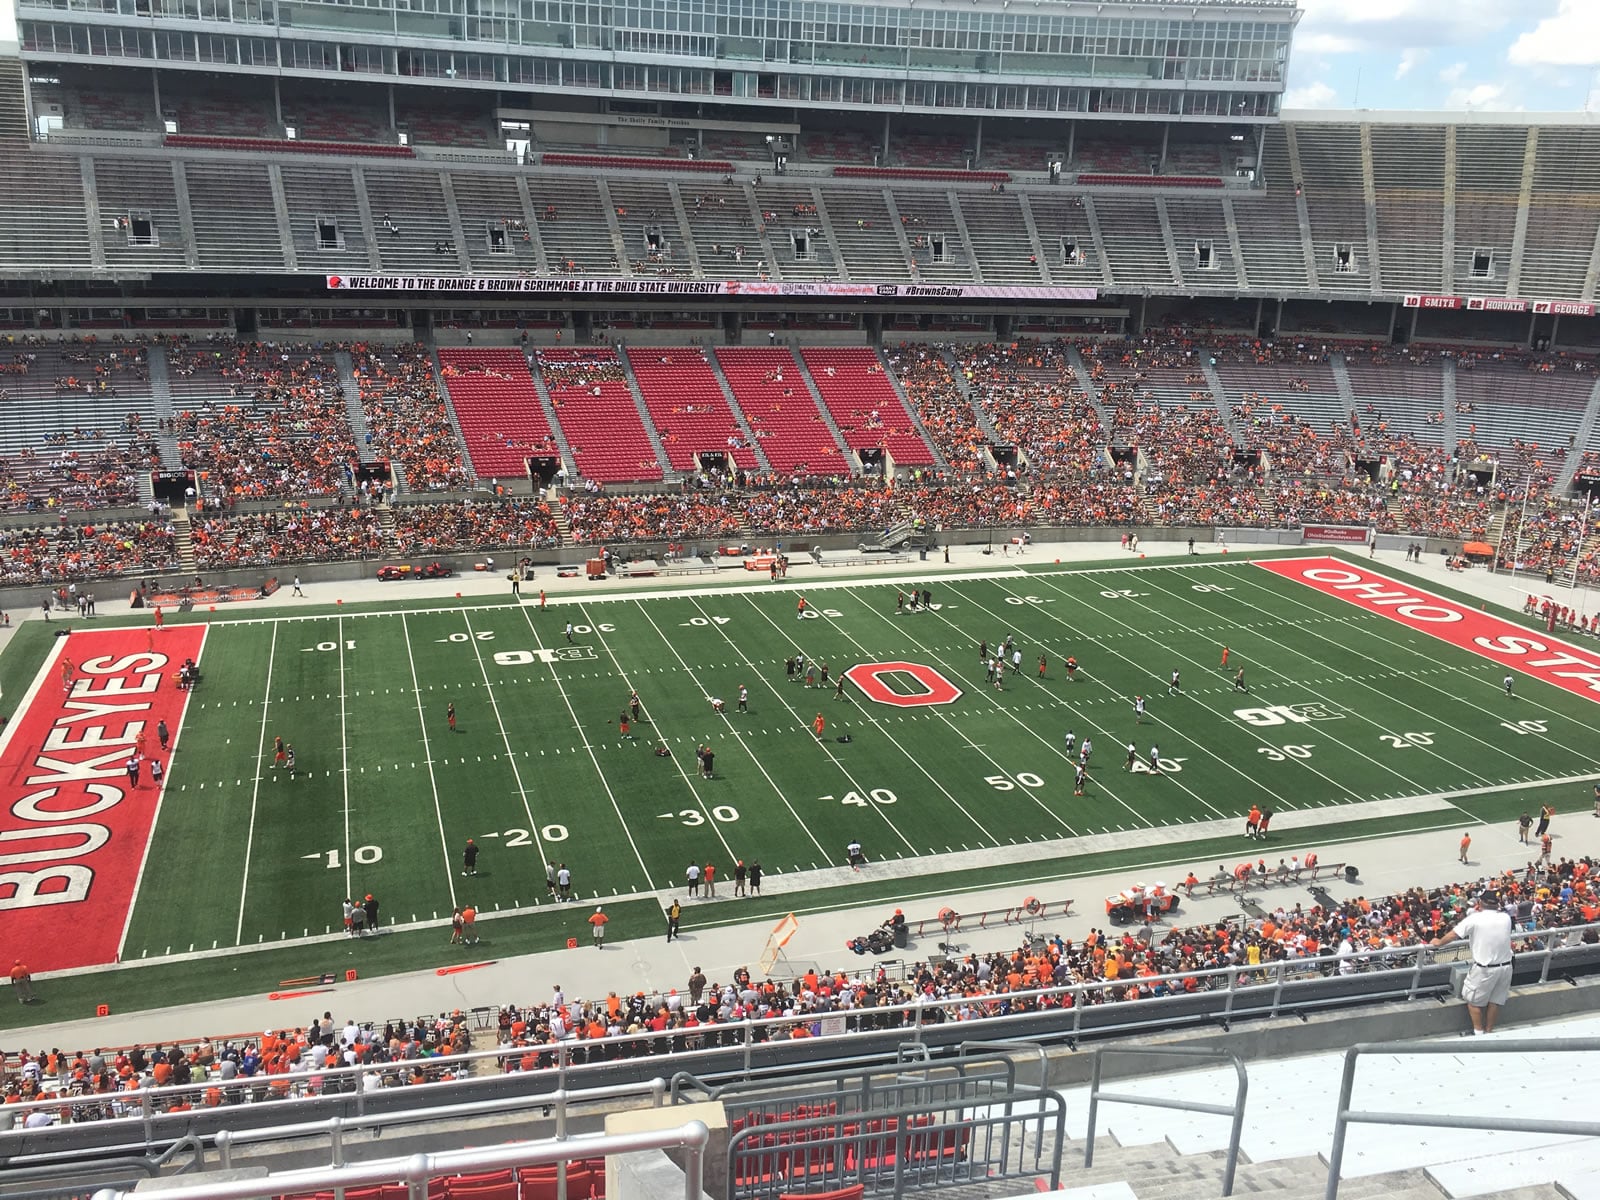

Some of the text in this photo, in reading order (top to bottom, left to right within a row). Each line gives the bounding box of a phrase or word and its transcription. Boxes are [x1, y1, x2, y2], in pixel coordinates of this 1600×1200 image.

[350, 278, 398, 288] WELCOME
[402, 279, 414, 289] TO
[418, 279, 437, 289] THE
[438, 279, 476, 290] ORANGE
[479, 280, 485, 290] &
[487, 280, 522, 290] BROWN
[524, 280, 580, 291] SCRIMMAGE
[582, 281, 592, 291] AT
[597, 281, 612, 291] THE
[615, 281, 637, 292] OHIO
[639, 282, 666, 292] STATE
[668, 282, 721, 293] UNIVERSITY
[905, 286, 963, 297] #BrownsCamp
[1406, 298, 1455, 308] 10 SMITH
[1469, 300, 1524, 311] 22 HORVATH
[1535, 304, 1589, 314] 27 GEORGE
[1100, 589, 1140, 599] 20
[1191, 584, 1226, 593] 10
[1302, 568, 1464, 623] OHIO
[1004, 596, 1044, 605] 30
[689, 616, 731, 627] 40
[802, 609, 844, 619] 50
[573, 623, 616, 634] 30
[449, 630, 495, 643] 20
[316, 640, 357, 652] 10
[843, 661, 964, 707] O
[1500, 719, 1548, 735] 10
[1379, 732, 1434, 749] 20
[1257, 744, 1312, 761] 30
[1131, 758, 1183, 774] 40
[0, 651, 169, 910] BUCKEYES
[984, 772, 1045, 791] 50
[841, 788, 897, 807] 40
[679, 805, 740, 827] 30
[503, 824, 570, 848] 20
[325, 845, 383, 869] 10
